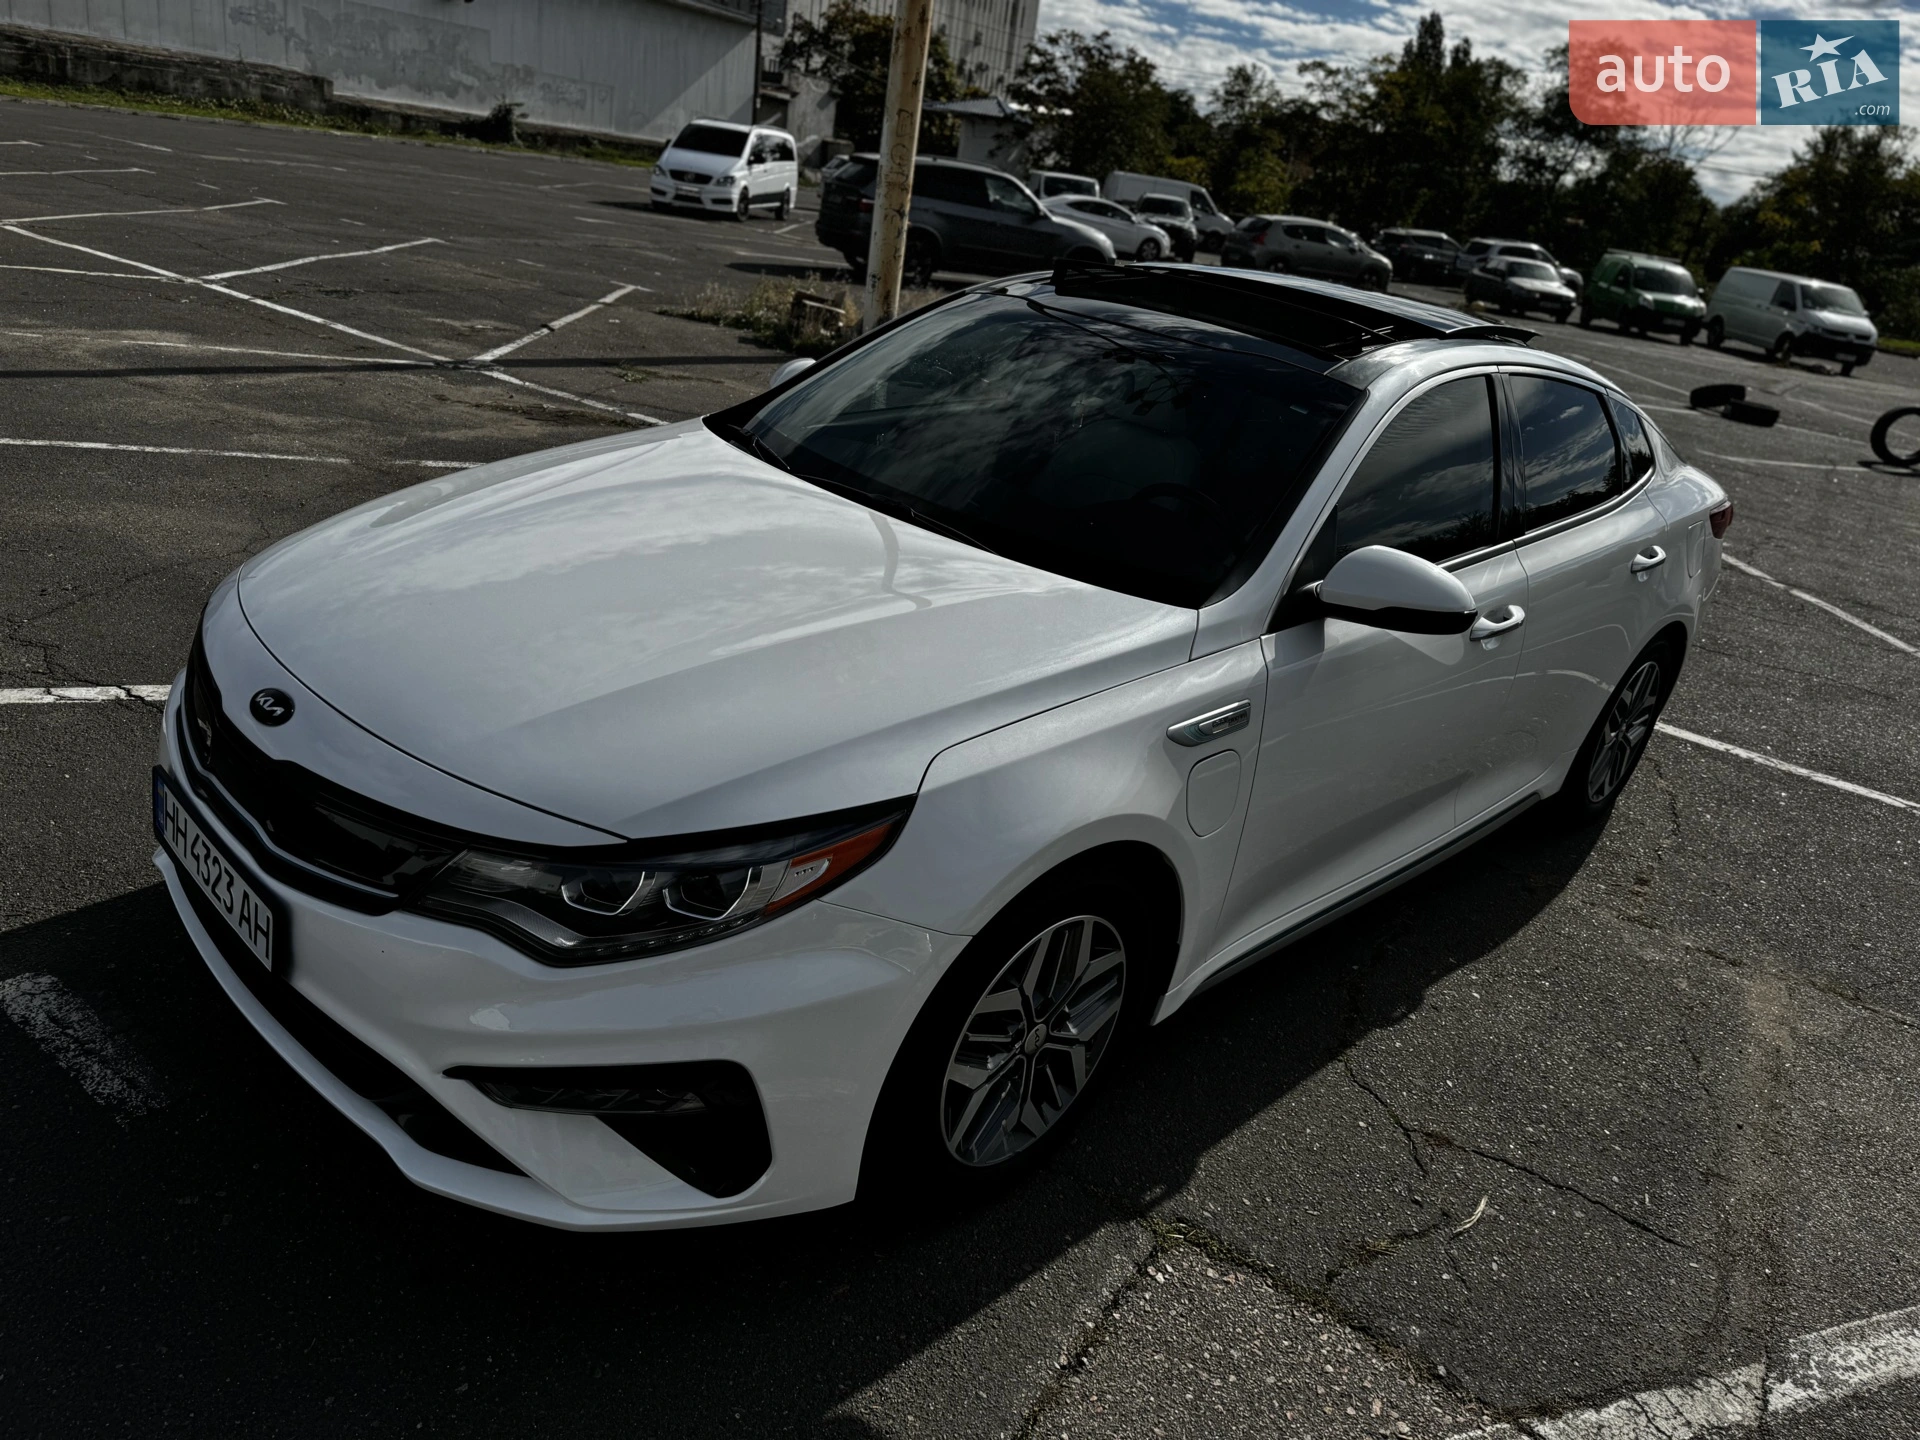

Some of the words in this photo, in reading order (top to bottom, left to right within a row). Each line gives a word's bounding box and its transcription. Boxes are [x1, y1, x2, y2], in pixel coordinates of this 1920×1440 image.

[164, 790, 187, 859] HH
[190, 833, 234, 915] 4323
[239, 889, 270, 959] AH
